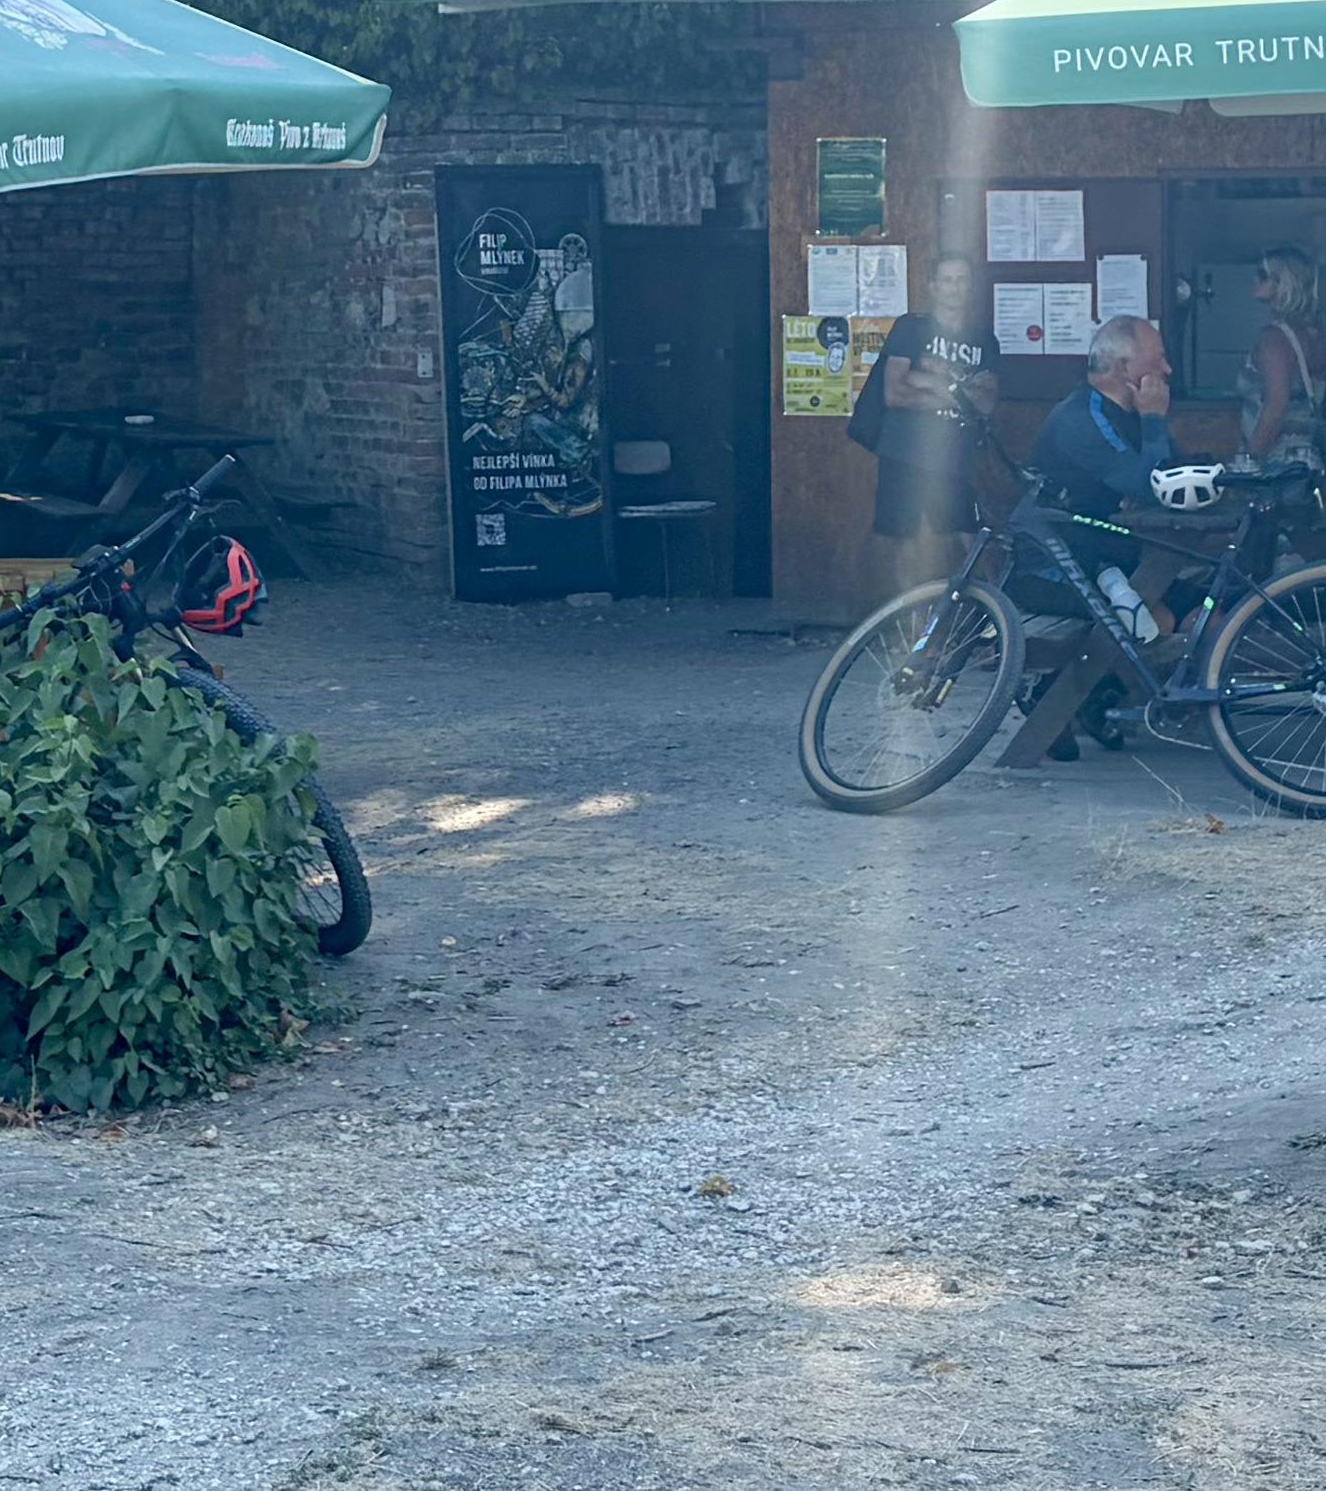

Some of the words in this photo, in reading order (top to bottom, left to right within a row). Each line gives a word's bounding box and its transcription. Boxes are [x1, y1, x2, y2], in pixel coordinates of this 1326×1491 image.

[1053, 42, 1194, 72] PIVOVAR
[12, 133, 65, 167] Trutnov
[479, 234, 507, 249] FILIP
[473, 452, 519, 469] NEJLEPŠÍ
[489, 475, 522, 490] FILIPA
[524, 472, 568, 488] MLÝNKA
